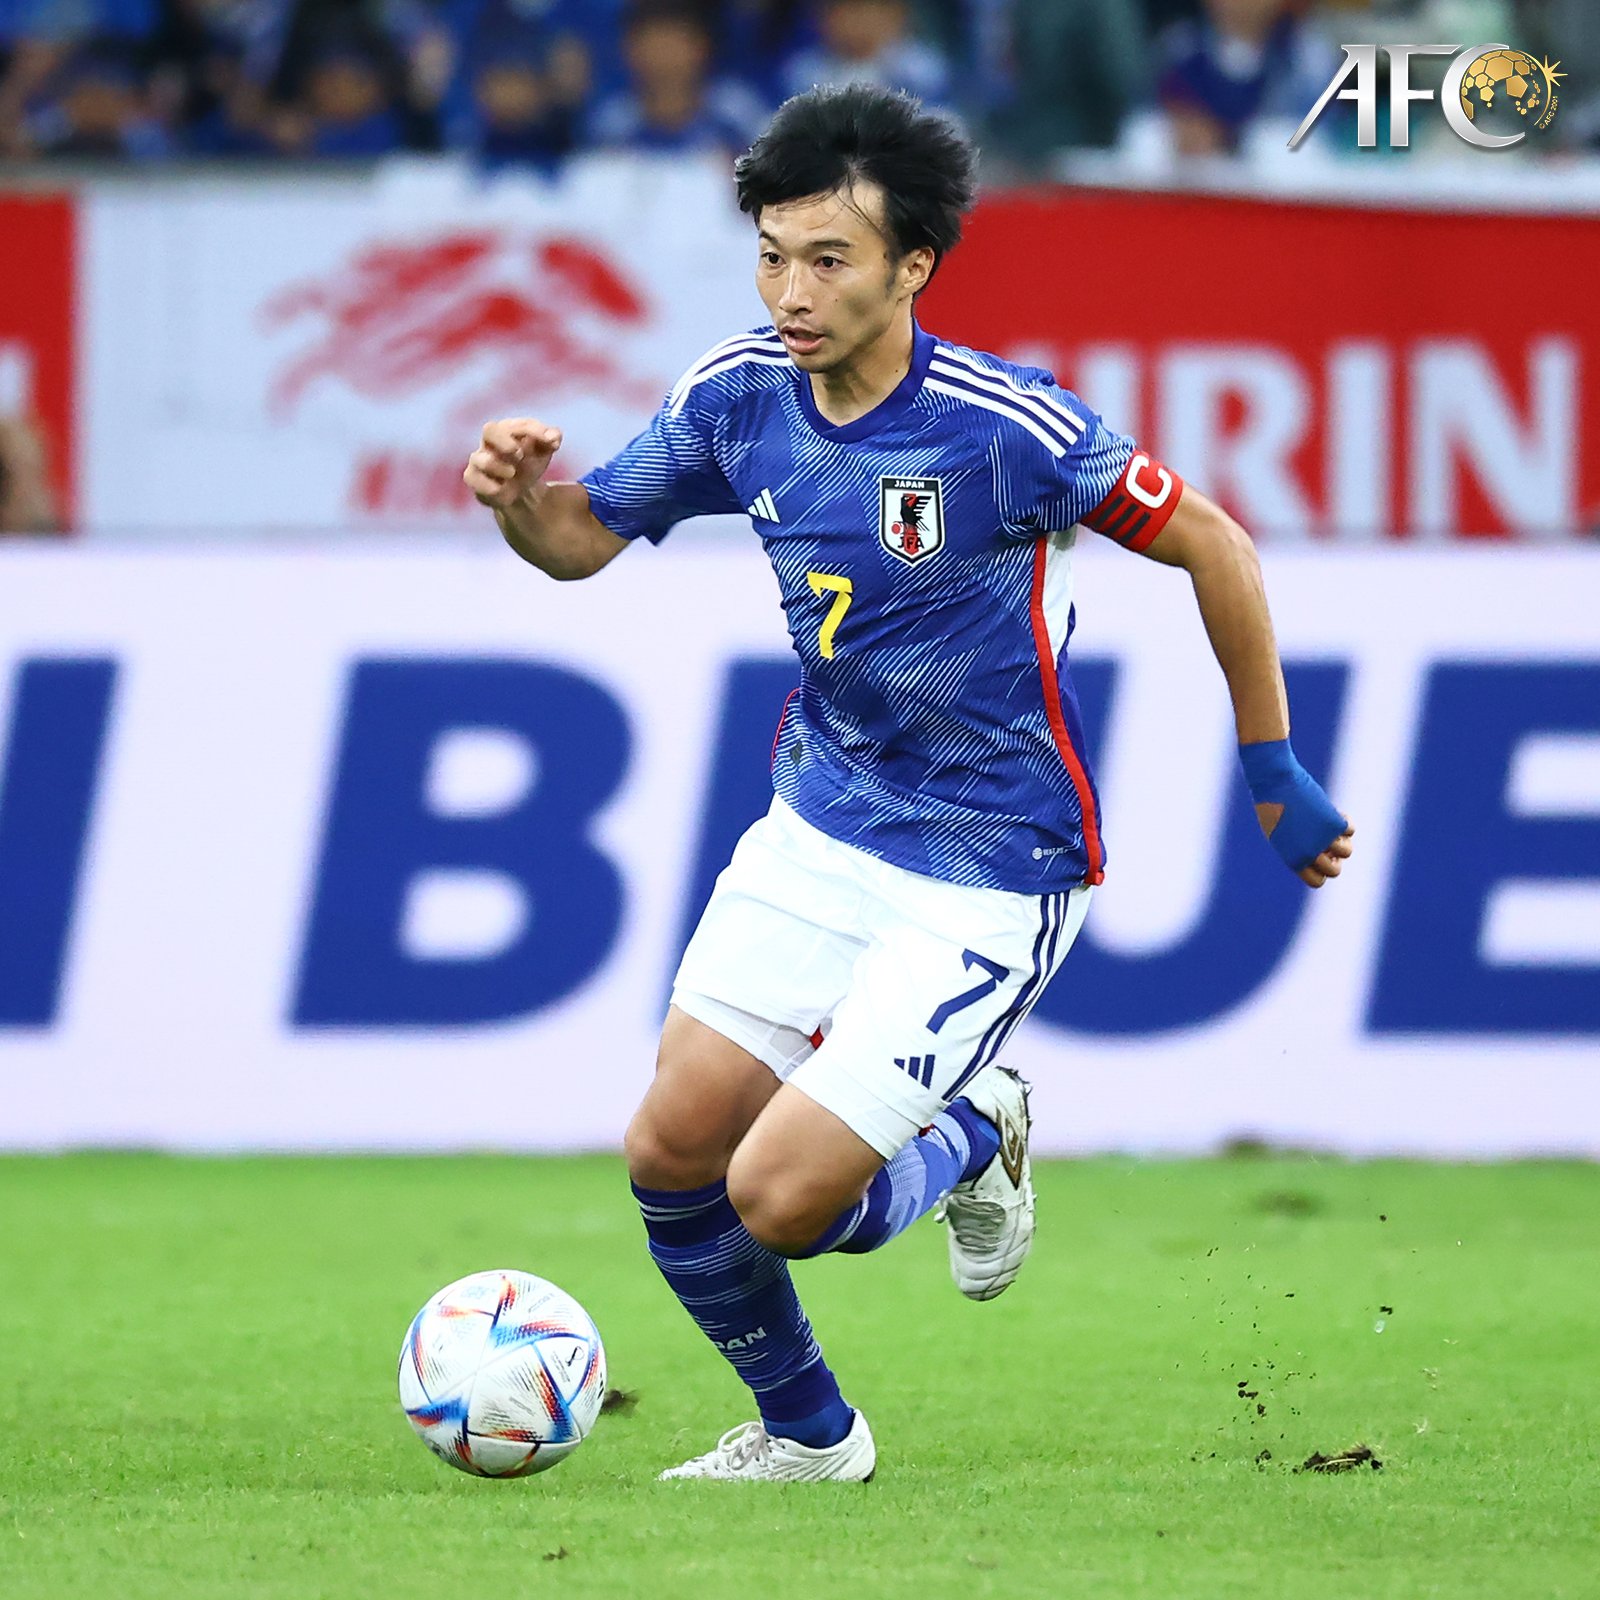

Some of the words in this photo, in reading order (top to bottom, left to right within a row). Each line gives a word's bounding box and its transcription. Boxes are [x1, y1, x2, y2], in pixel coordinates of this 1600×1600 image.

[894, 480, 925, 489] JAPAN
[1126, 455, 1172, 509] C
[897, 535, 925, 549] JFA
[806, 571, 853, 660] 7
[926, 948, 1010, 1035] 7
